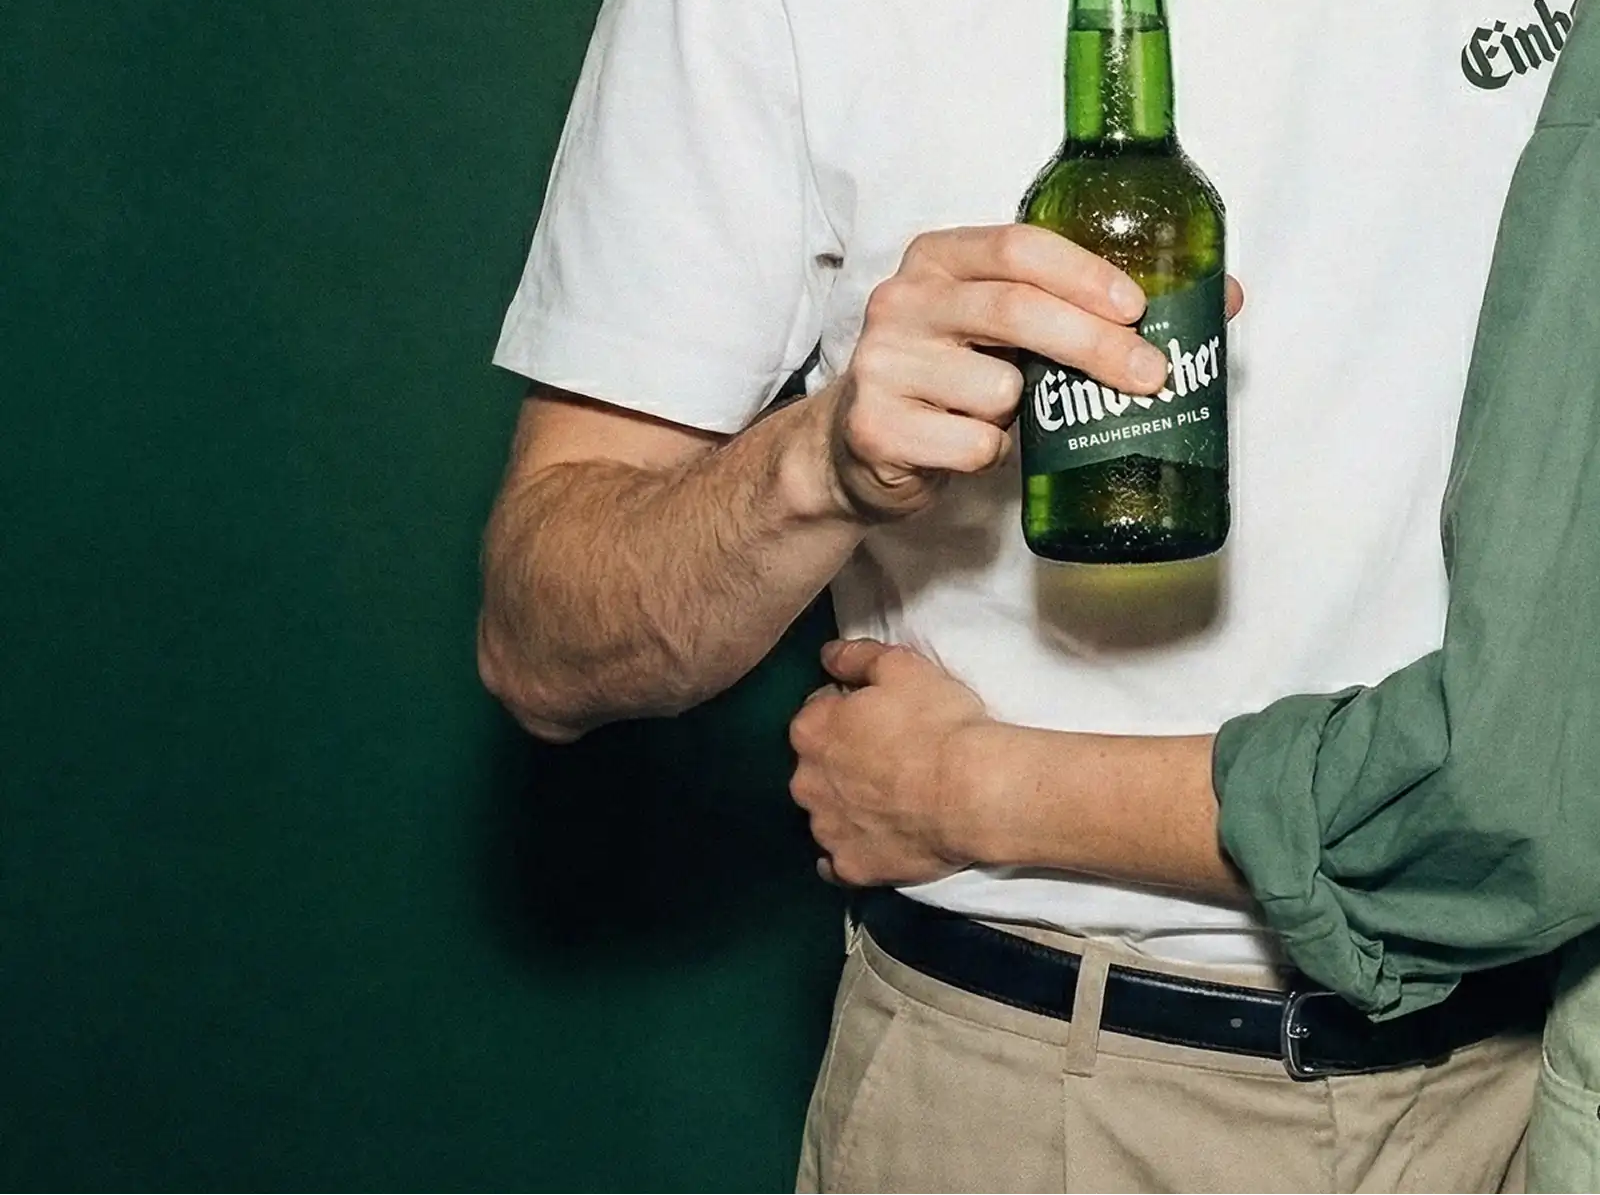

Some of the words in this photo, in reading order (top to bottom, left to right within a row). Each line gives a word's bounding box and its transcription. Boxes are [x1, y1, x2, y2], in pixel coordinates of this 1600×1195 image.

[1034, 336, 1219, 431] Einker
[1068, 417, 1173, 451] BRAUHERREN
[1177, 407, 1211, 427] PILS
